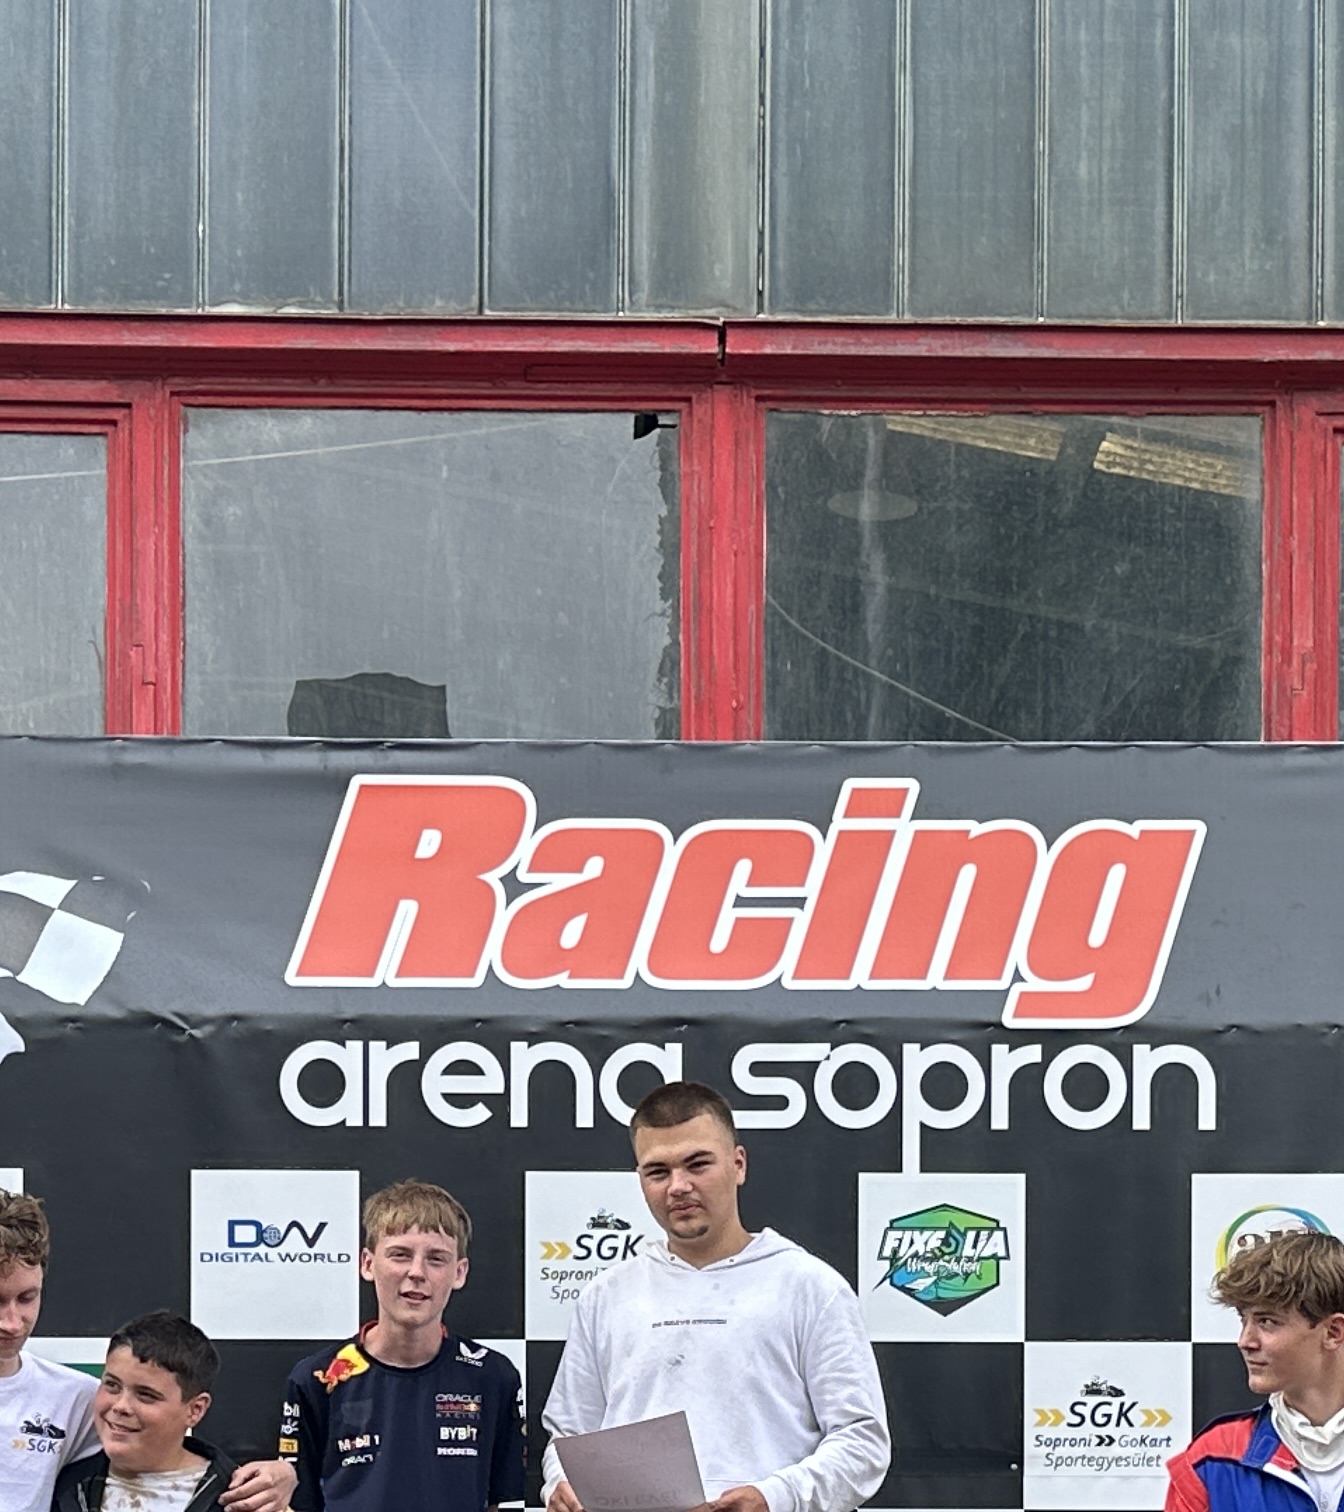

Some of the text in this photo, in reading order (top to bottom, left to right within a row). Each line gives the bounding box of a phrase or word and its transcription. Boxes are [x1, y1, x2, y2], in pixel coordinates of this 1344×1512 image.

[284, 774, 1206, 1029] Racing
[279, 1040, 1217, 1178] arena sopron
[199, 1250, 351, 1264] DIGITAL WORLD
[572, 1233, 645, 1261] SGK
[1066, 1401, 1138, 1428] SGK
[26, 1438, 59, 1455] SGK
[1033, 1433, 1172, 1451] Soproni GoKart
[1043, 1451, 1162, 1471] Sportegyesület
